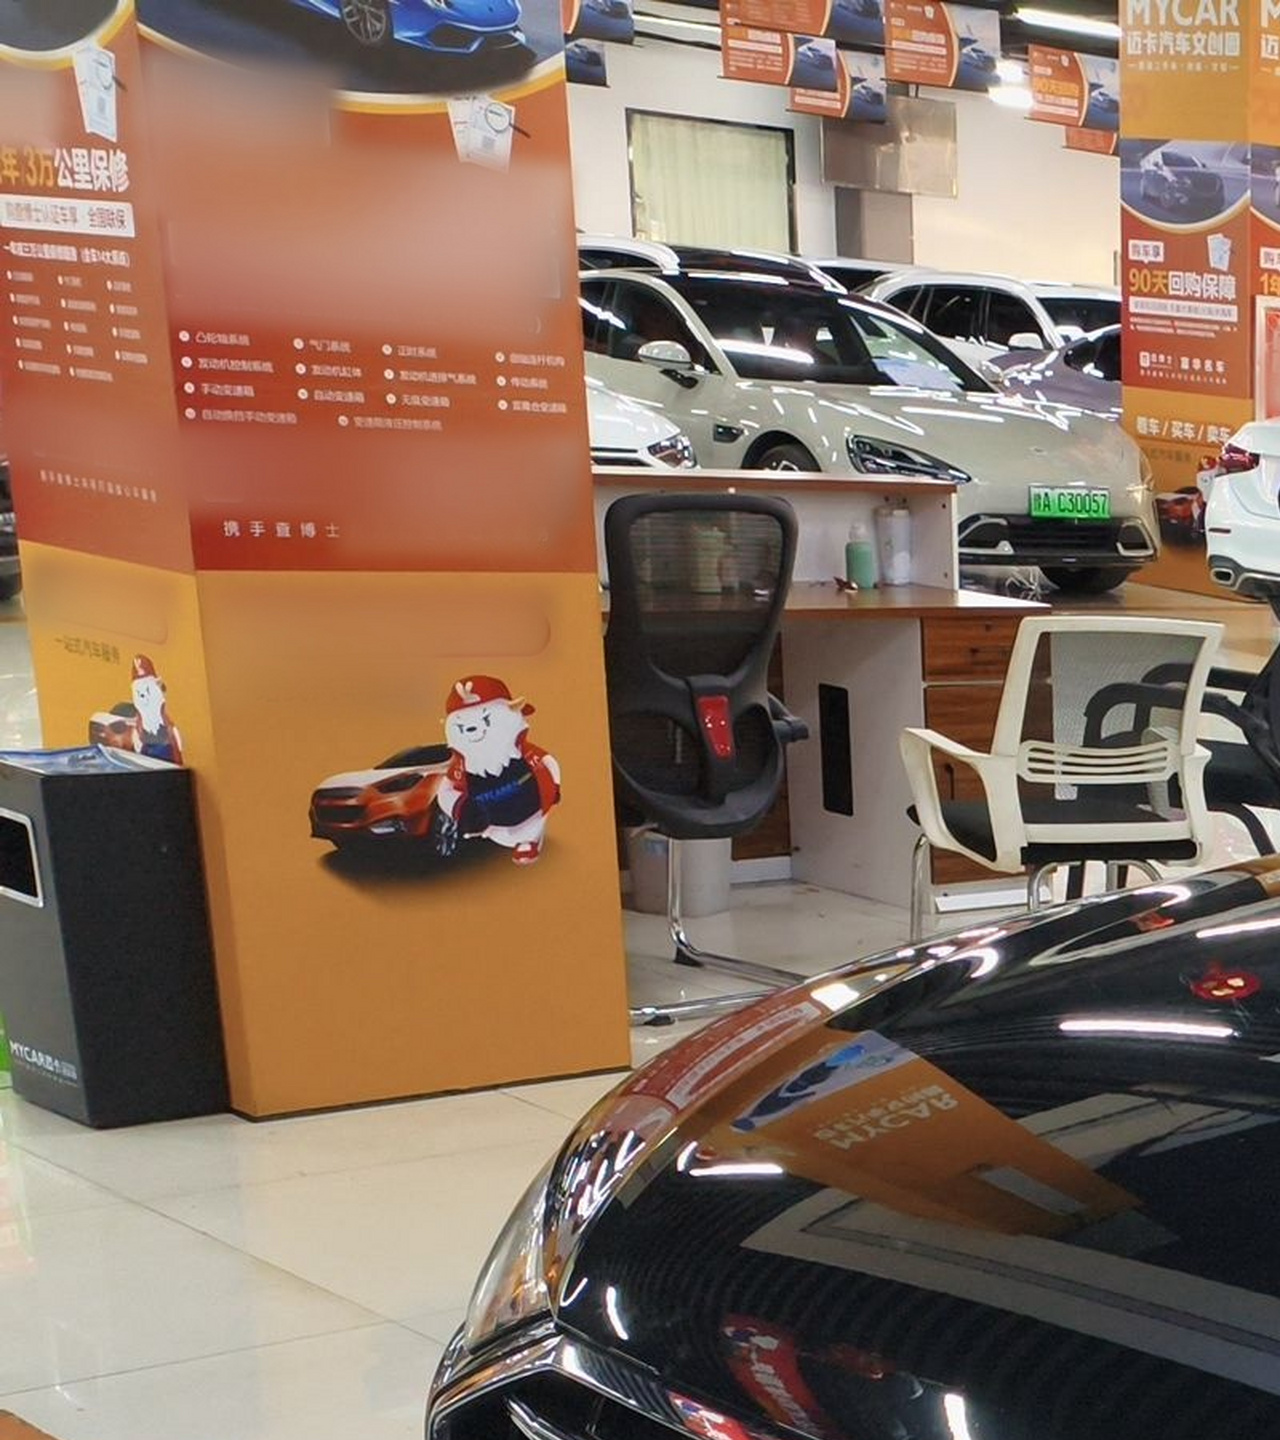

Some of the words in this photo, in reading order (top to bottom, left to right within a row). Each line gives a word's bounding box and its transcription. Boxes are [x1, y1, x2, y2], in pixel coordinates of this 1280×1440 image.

[1126, 0, 1240, 26] MYCAR
[1126, 31, 1241, 57] 迈卡汽车文创园
[1128, 267, 1237, 301] 90天回购保障
[1057, 492, 1109, 515] C30057
